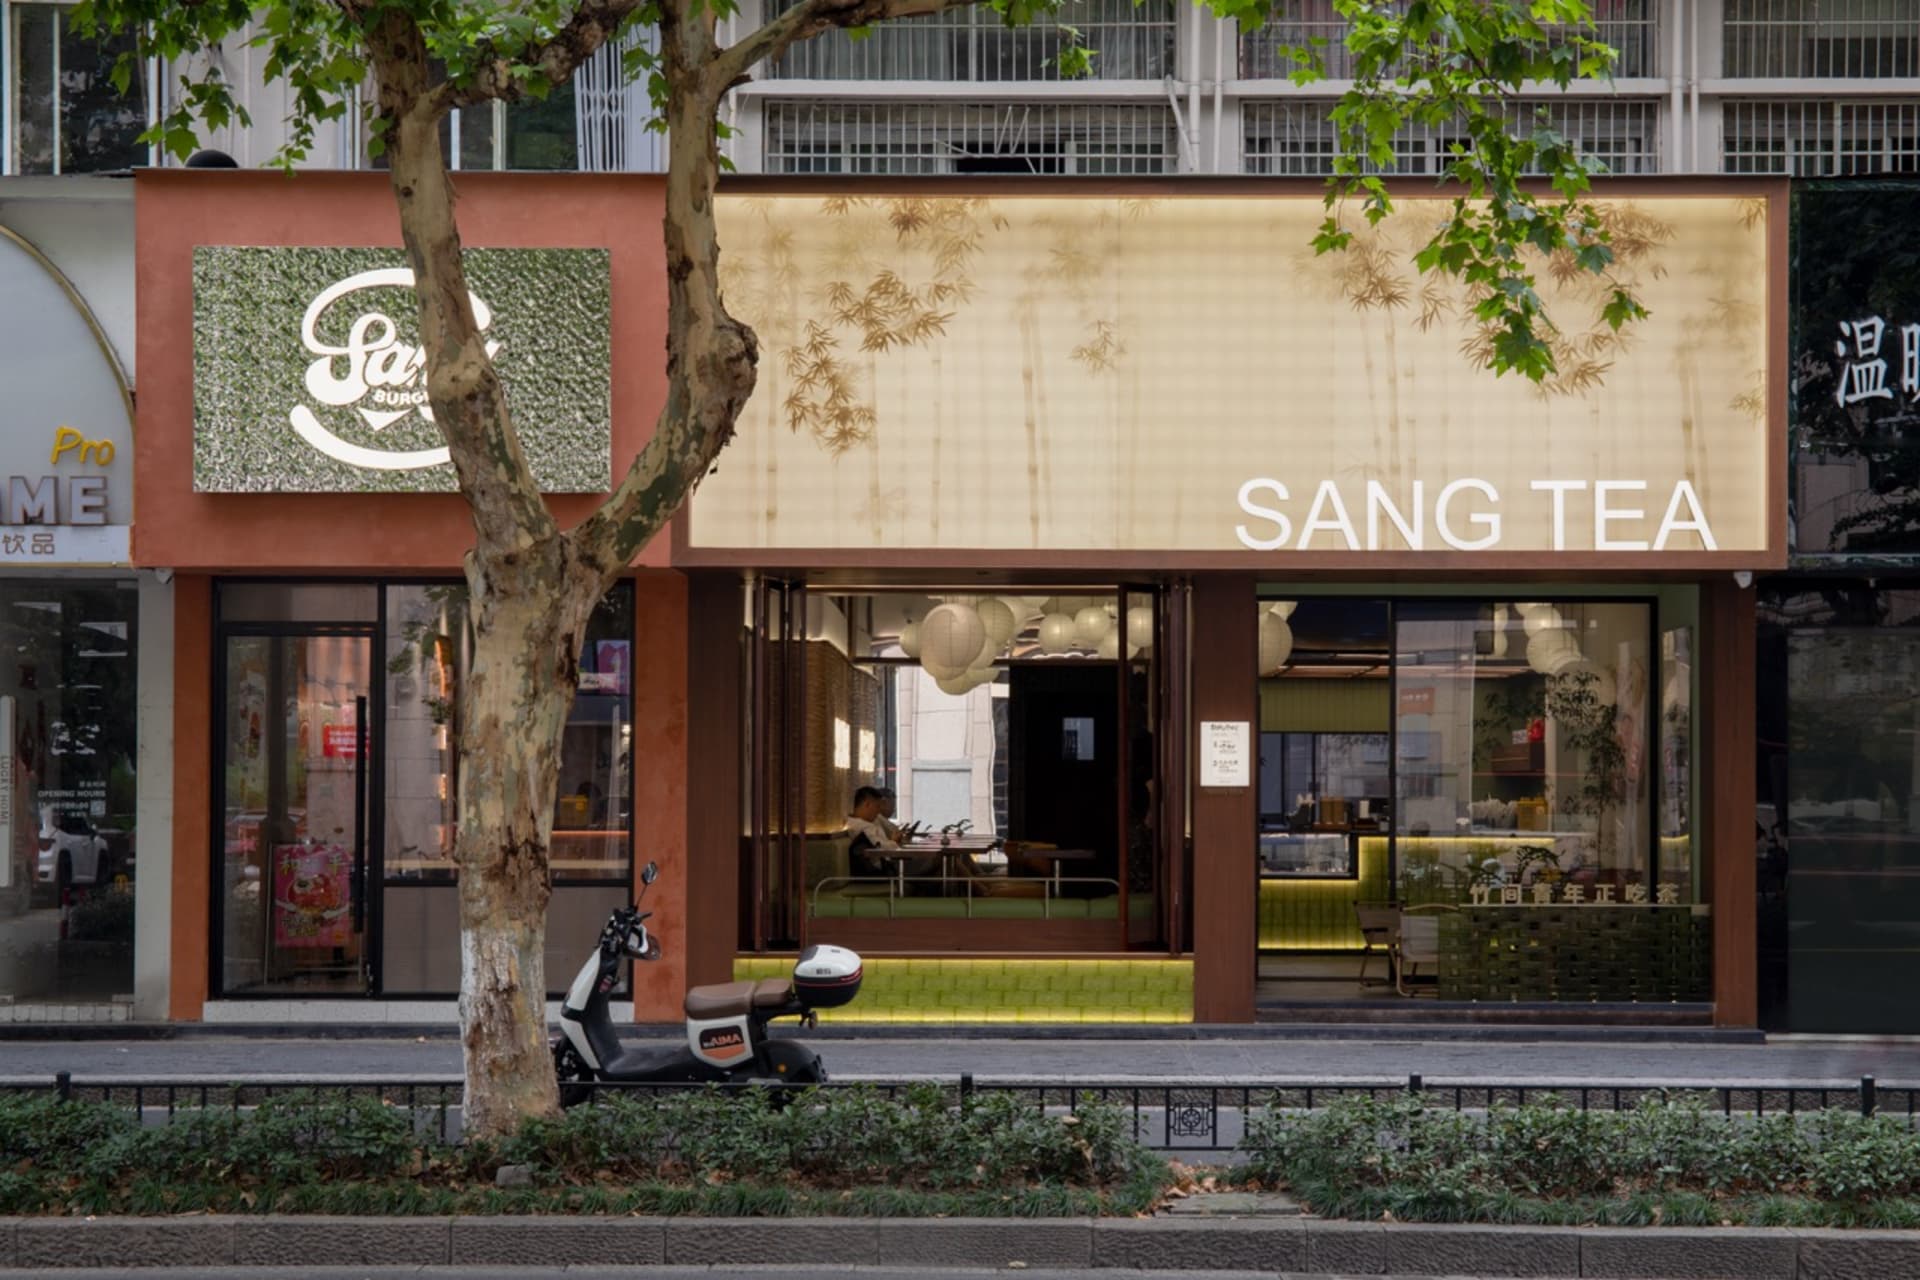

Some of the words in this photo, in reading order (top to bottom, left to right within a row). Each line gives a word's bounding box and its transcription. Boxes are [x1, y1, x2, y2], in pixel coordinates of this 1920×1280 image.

[302, 268, 500, 406] Sa
[373, 389, 429, 405] BURG
[51, 425, 115, 466] Pro
[0, 475, 109, 527] ME
[1235, 478, 1502, 551] SANG
[1530, 479, 1718, 551] TEA
[2, 533, 55, 555] 饮品
[38, 790, 75, 798] OPENING
[77, 790, 106, 798] HOURS
[711, 1033, 742, 1047] AIMA
